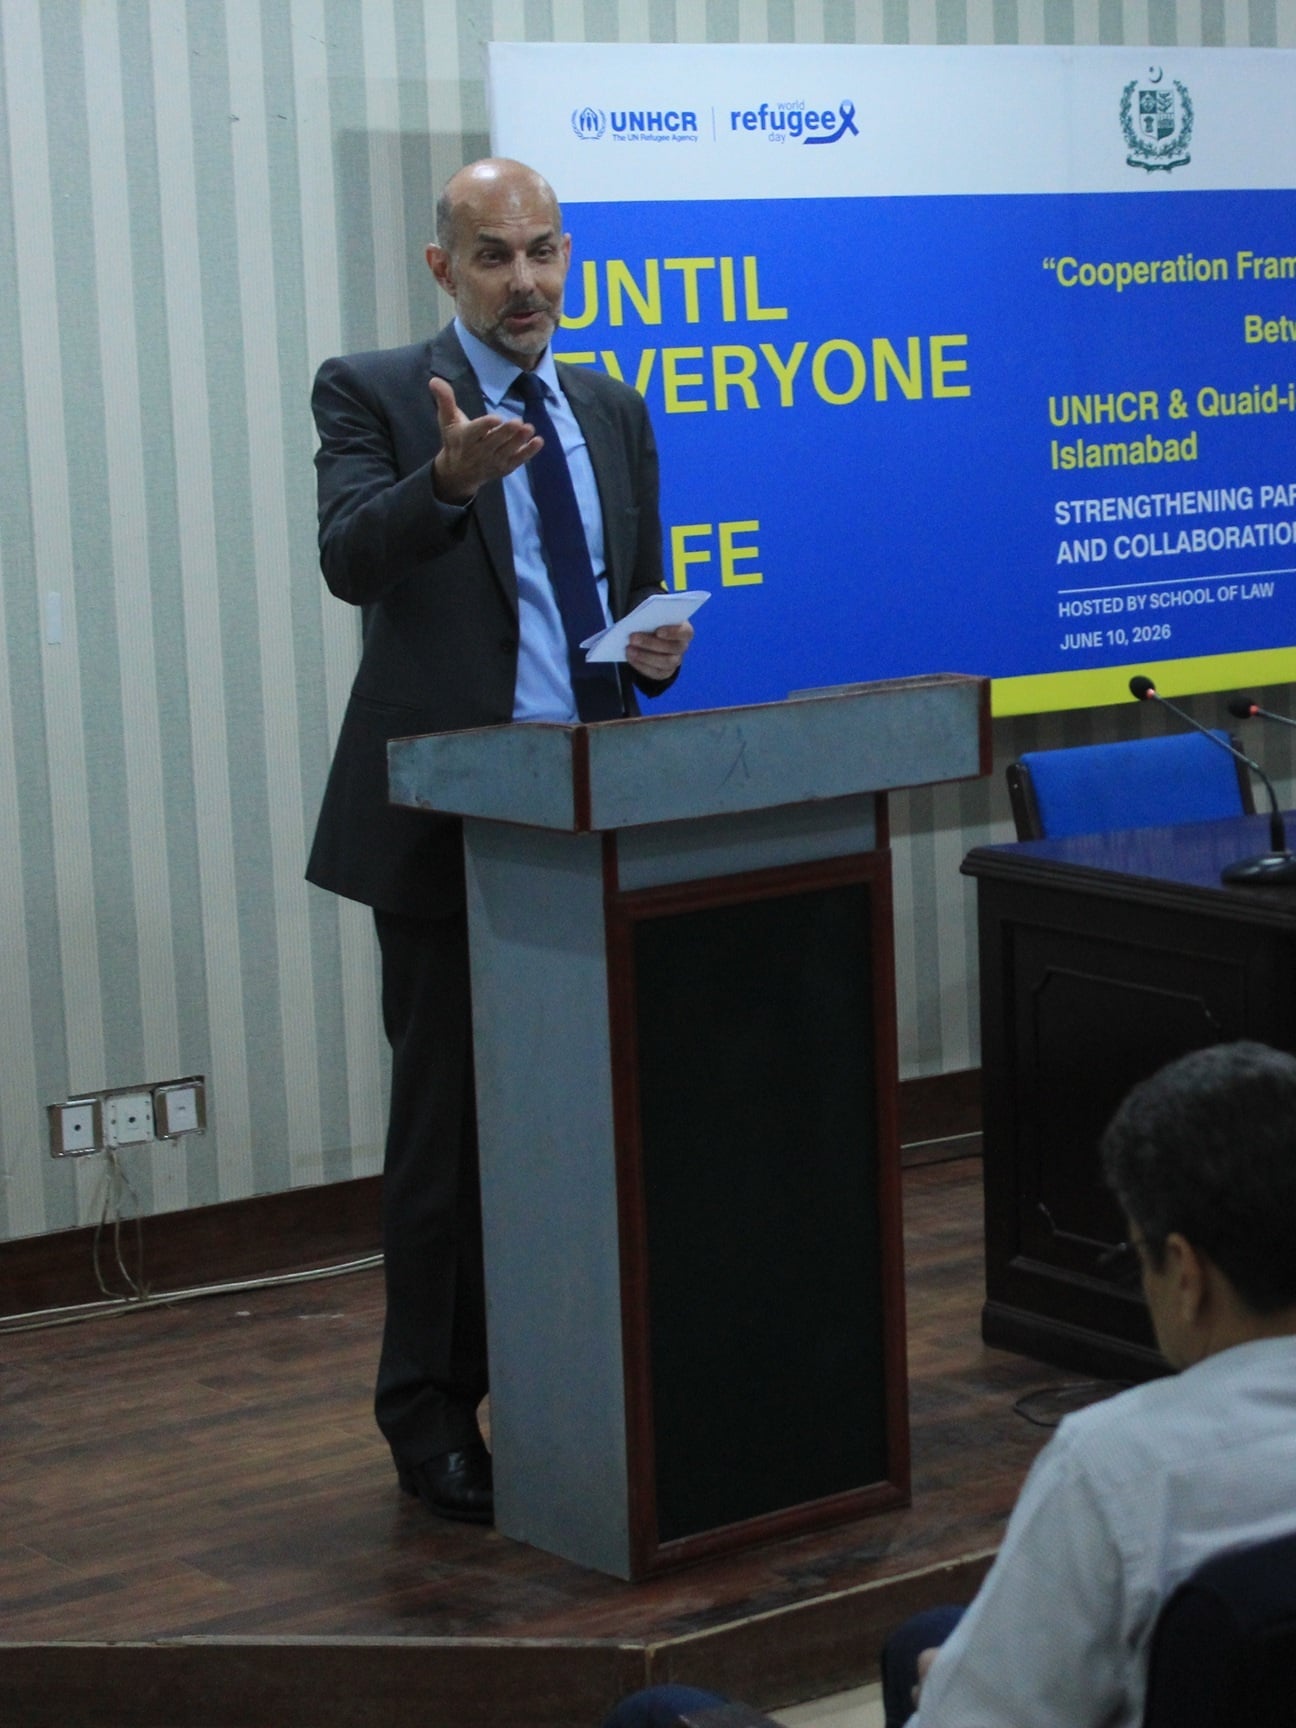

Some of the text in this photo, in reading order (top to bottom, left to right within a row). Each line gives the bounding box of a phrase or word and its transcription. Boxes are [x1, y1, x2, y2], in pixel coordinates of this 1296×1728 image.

[610, 110, 698, 132] UNHCR
[730, 102, 837, 138] refugee
[776, 99, 806, 111] world
[767, 131, 787, 145] day
[558, 255, 789, 330] UNTIL
[1048, 389, 1160, 427] UNHCR
[1168, 387, 1189, 420] &
[1050, 431, 1199, 470] Islamabad
[1054, 486, 1254, 525] STRENGTHENING
[660, 519, 764, 592] FE
[1056, 537, 1109, 565] AND
[1057, 581, 1276, 618] HOSTED BY SCHOOL OF LAW
[1059, 622, 1172, 650] JUNE 10, 2026
